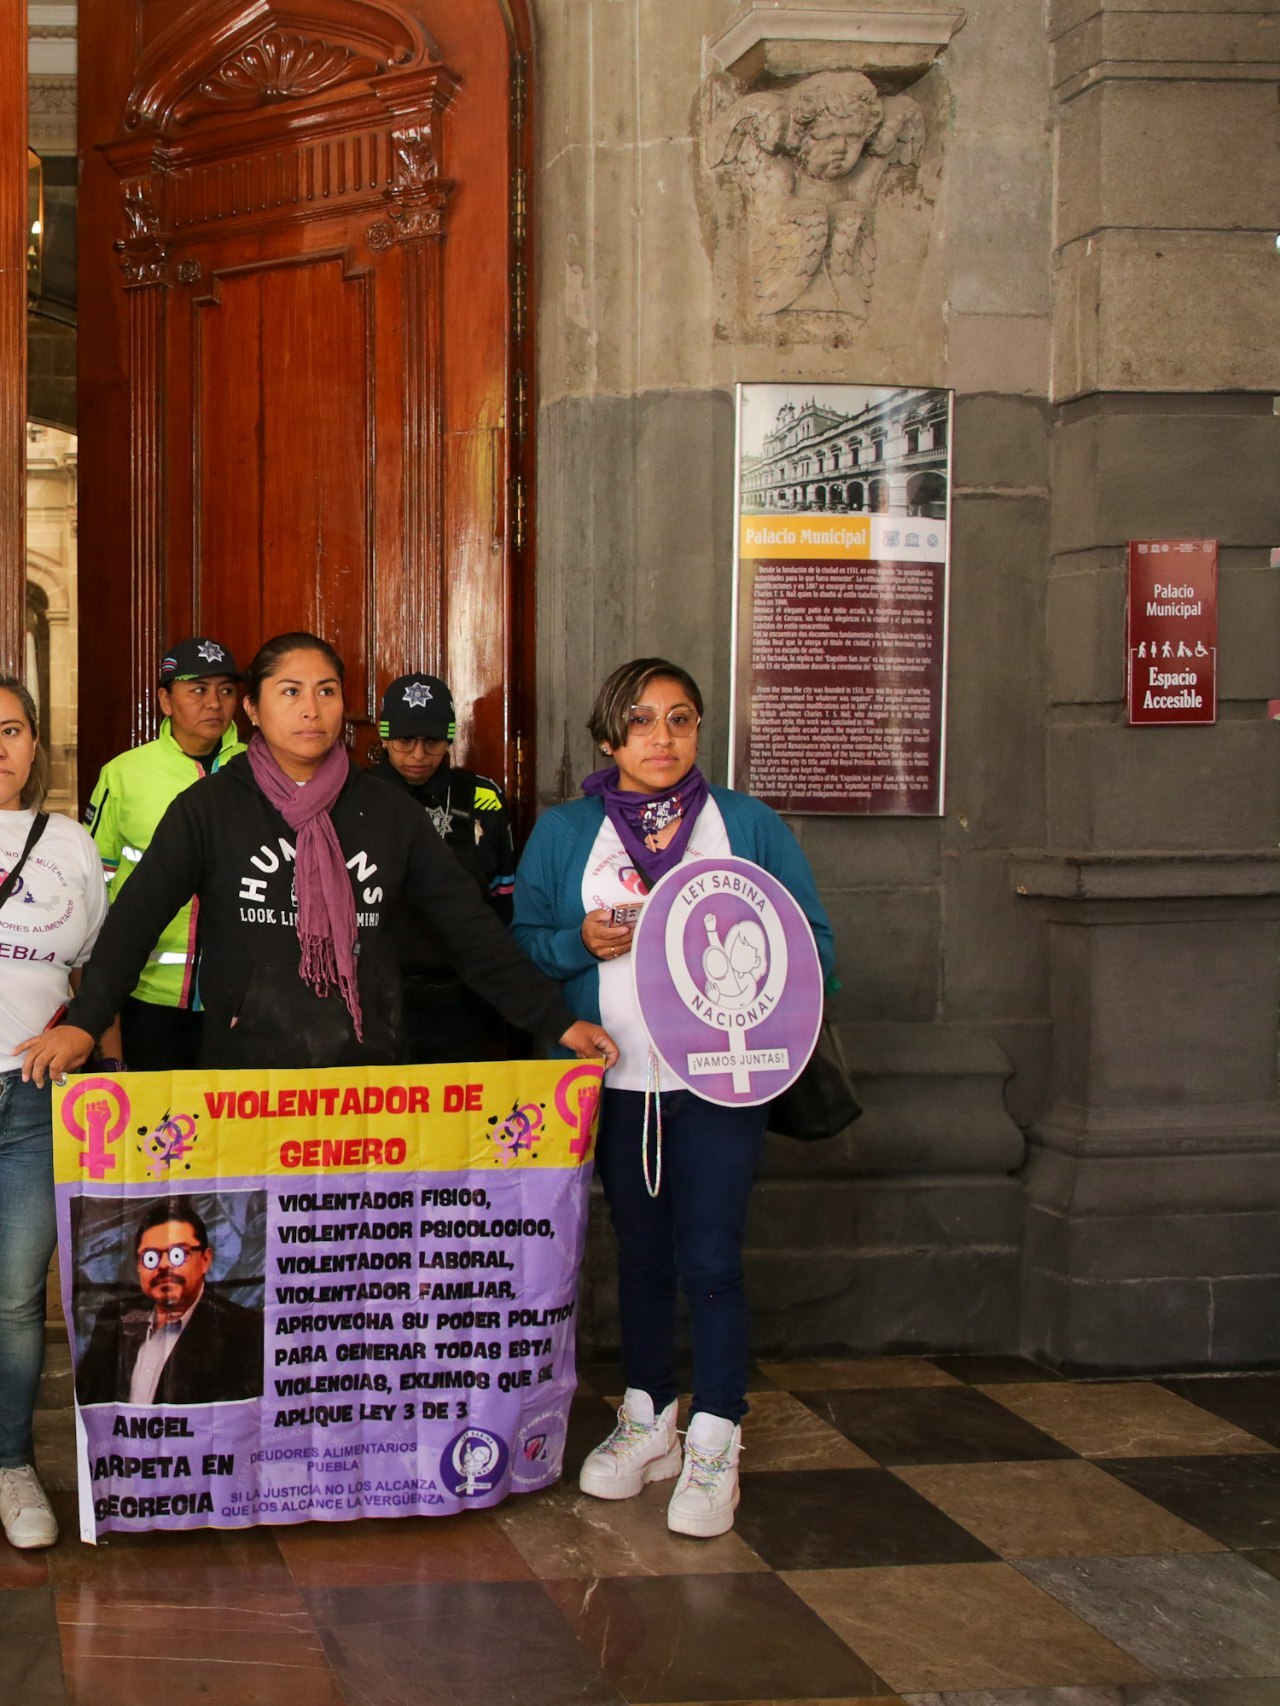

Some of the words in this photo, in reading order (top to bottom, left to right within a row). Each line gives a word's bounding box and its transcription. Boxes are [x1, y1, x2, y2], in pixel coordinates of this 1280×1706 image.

[746, 528, 797, 545] Palacio
[800, 528, 867, 548] Municipal
[1154, 584, 1194, 599] Palacio
[1146, 601, 1201, 619] Municipal
[1149, 666, 1197, 689] Espacio
[1143, 689, 1202, 709] Accesible
[681, 879, 706, 906] LEY
[711, 874, 767, 913] SABINA
[239, 907, 277, 925] LOOK
[690, 993, 776, 1028] NACIONAL
[692, 1055, 737, 1072] ¡VAMOS
[739, 1052, 785, 1066] JUNTAS!
[203, 1086, 430, 1120] VIOLENTADOR
[442, 1084, 484, 1113] DE
[279, 1137, 406, 1168] GENERO
[277, 1190, 414, 1212] VIOLENTADOR
[421, 1188, 491, 1210] FISICO,
[277, 1221, 413, 1244] VIOLENTADOR
[420, 1218, 555, 1240] PSICOLOGICO,
[276, 1252, 412, 1275] VIOLENTADOR
[419, 1250, 515, 1271] LABORAL,
[275, 1281, 411, 1304] VIOLENTADOR
[419, 1280, 516, 1301] FAMILIAR,
[275, 1312, 394, 1335] APROVECHA
[402, 1312, 429, 1331] SU
[436, 1311, 501, 1330] PODER
[274, 1345, 328, 1367] PARA
[335, 1341, 426, 1362] GENERAR
[434, 1340, 502, 1360] TODAS
[274, 1373, 393, 1397] VIOLENCIAS,
[399, 1369, 491, 1391] EXIJIMOS
[497, 1369, 533, 1392] QUE
[274, 1404, 353, 1428] APLIQUE
[359, 1403, 398, 1421] LEY
[403, 1402, 416, 1420] 3
[422, 1401, 449, 1419] DE
[456, 1401, 468, 1419] 3
[112, 1415, 195, 1440] ANGEL
[250, 1447, 320, 1464] DEUDORES
[323, 1442, 418, 1458] ALIMENTARIOS
[202, 1454, 235, 1477] EN
[307, 1459, 360, 1473] PUEBLA
[230, 1492, 243, 1504] SI
[246, 1489, 261, 1502] LA
[263, 1483, 321, 1500] JUSTICIA
[325, 1483, 346, 1496] NO
[348, 1480, 371, 1494] LOS
[375, 1478, 437, 1492] ALCANZA
[94, 1491, 215, 1522] SECRECIA
[221, 1506, 249, 1518] QUE
[252, 1502, 279, 1514] LOS
[281, 1497, 344, 1512] ALCANCE
[346, 1496, 362, 1509] LA
[364, 1492, 446, 1507] VERGÜENZA
